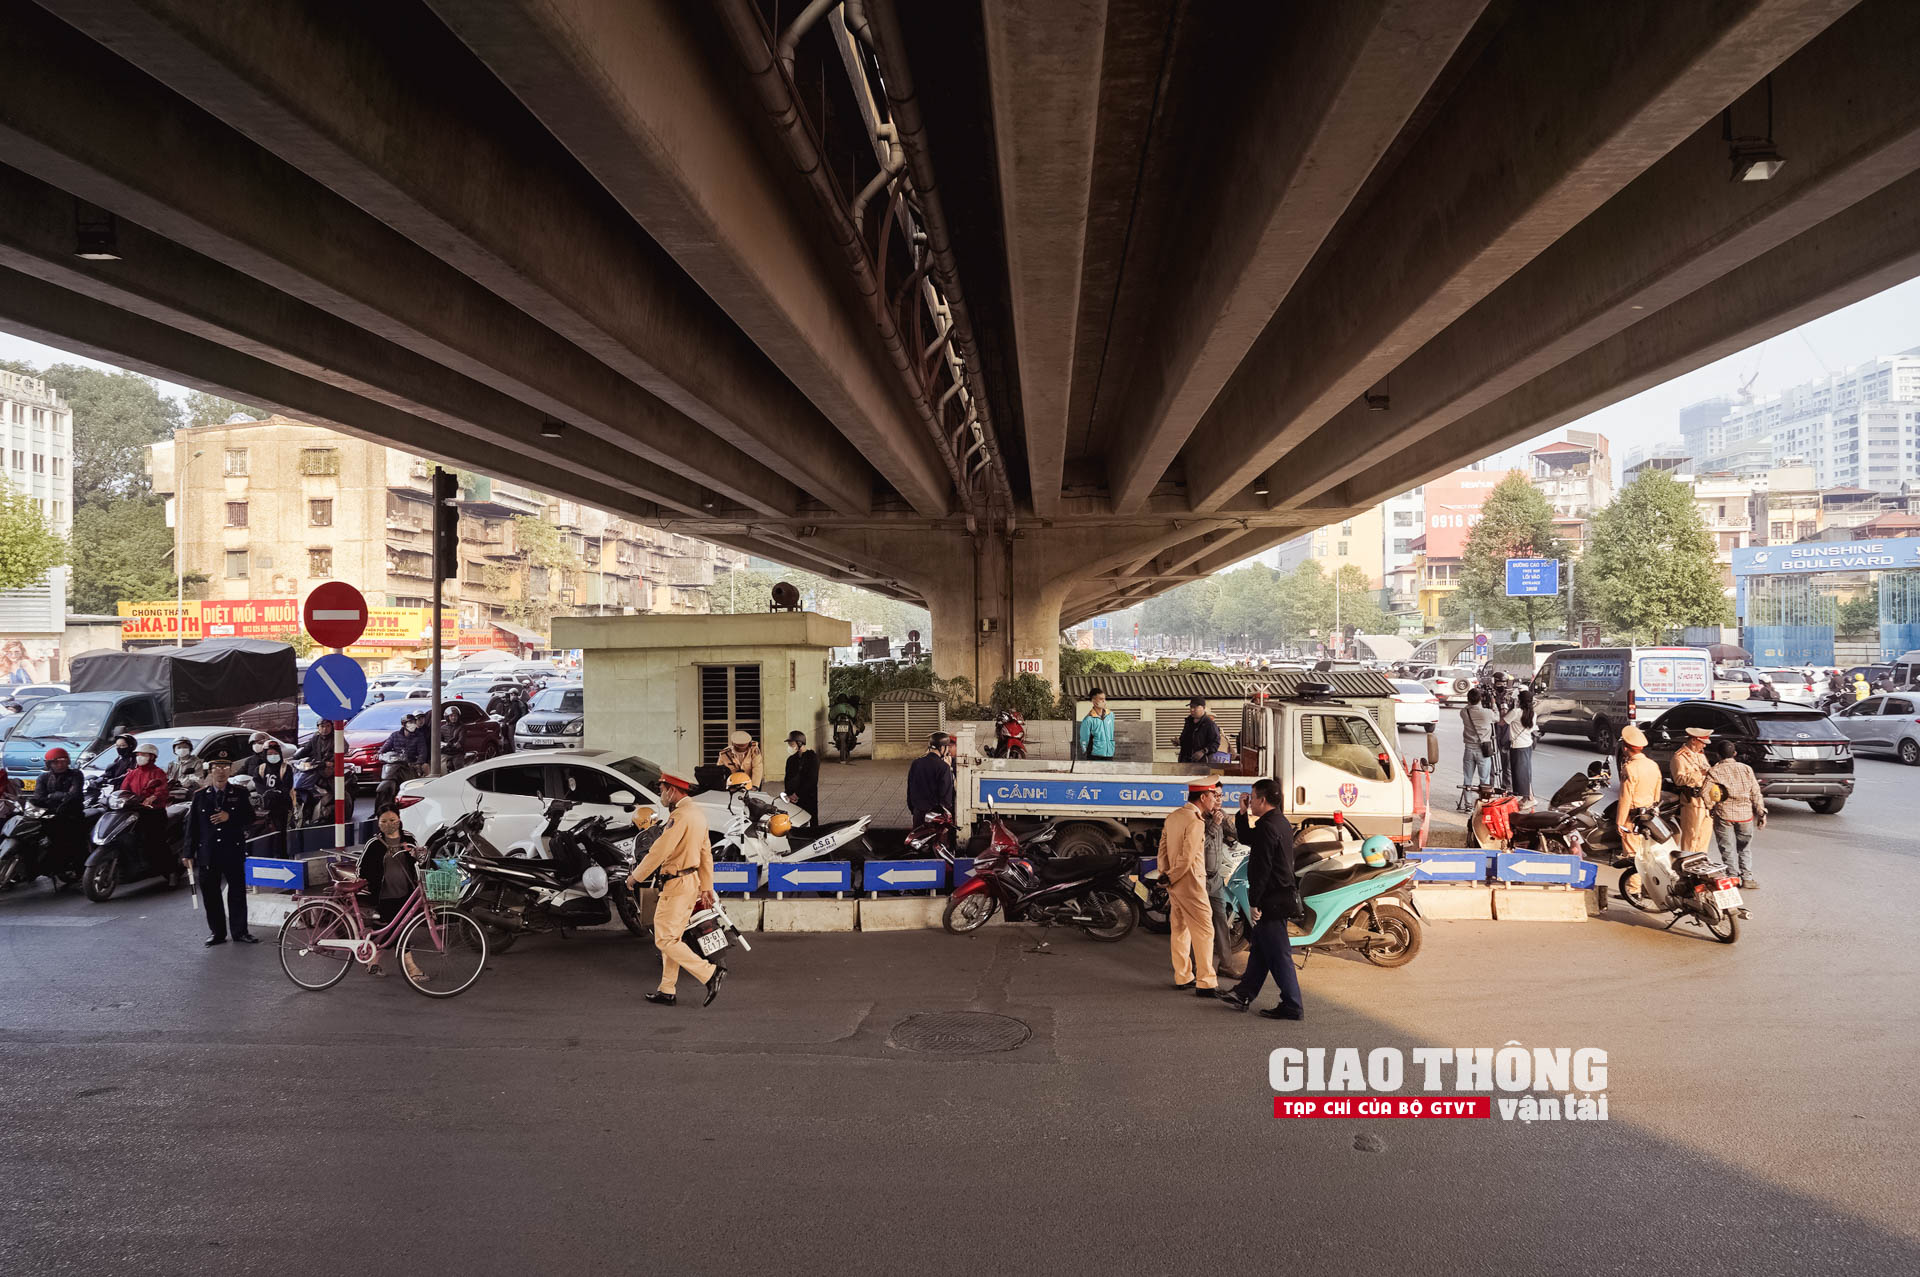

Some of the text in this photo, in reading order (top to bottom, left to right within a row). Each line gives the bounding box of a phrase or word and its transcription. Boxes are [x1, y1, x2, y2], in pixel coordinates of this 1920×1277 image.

[1791, 544, 1883, 558] SUNSHINE
[1781, 555, 1895, 570] BOULEVARD
[203, 605, 230, 625] DIỆT
[232, 602, 256, 622] MỐI
[264, 600, 296, 622] MUỖI
[1018, 661, 1039, 672] T180
[265, 774, 277, 787] 16
[997, 784, 1047, 799] CẢNH
[1119, 789, 1164, 801] GIAO
[1180, 790, 1240, 802] TNG
